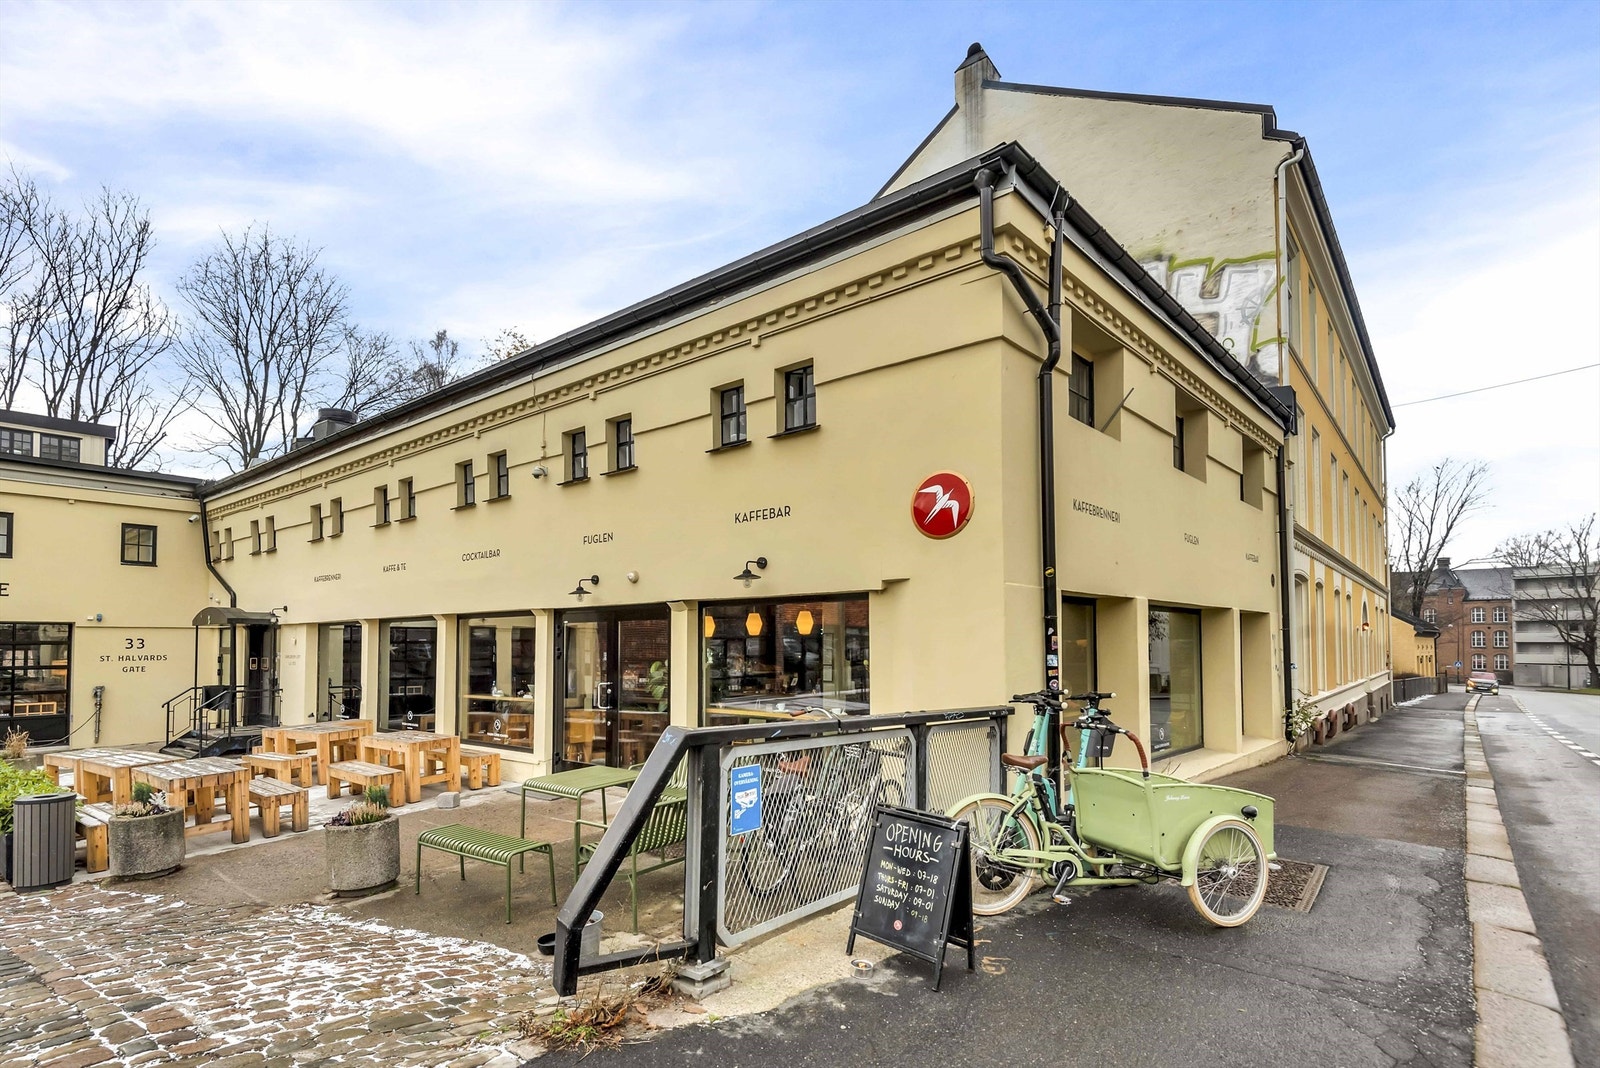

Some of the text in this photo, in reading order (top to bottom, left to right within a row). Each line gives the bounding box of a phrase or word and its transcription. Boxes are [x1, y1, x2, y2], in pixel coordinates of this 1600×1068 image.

[734, 505, 792, 524] KAFFEBAR
[1072, 499, 1121, 523] KAFFEBRENNERI
[583, 532, 614, 545] FUGLEN
[1184, 533, 1200, 546] FUGLEN
[461, 549, 501, 562] COCKTAILBAR
[382, 564, 396, 573] KAFFE
[400, 562, 406, 571] TE
[125, 638, 145, 650] 33
[118, 654, 168, 662] HALVARDS
[885, 823, 943, 853] OPENING
[880, 860, 911, 876] MON-WED
[878, 872, 908, 891] THURS-FRI
[876, 884, 908, 902] SATURDAY
[874, 895, 900, 910] SUNDAY
